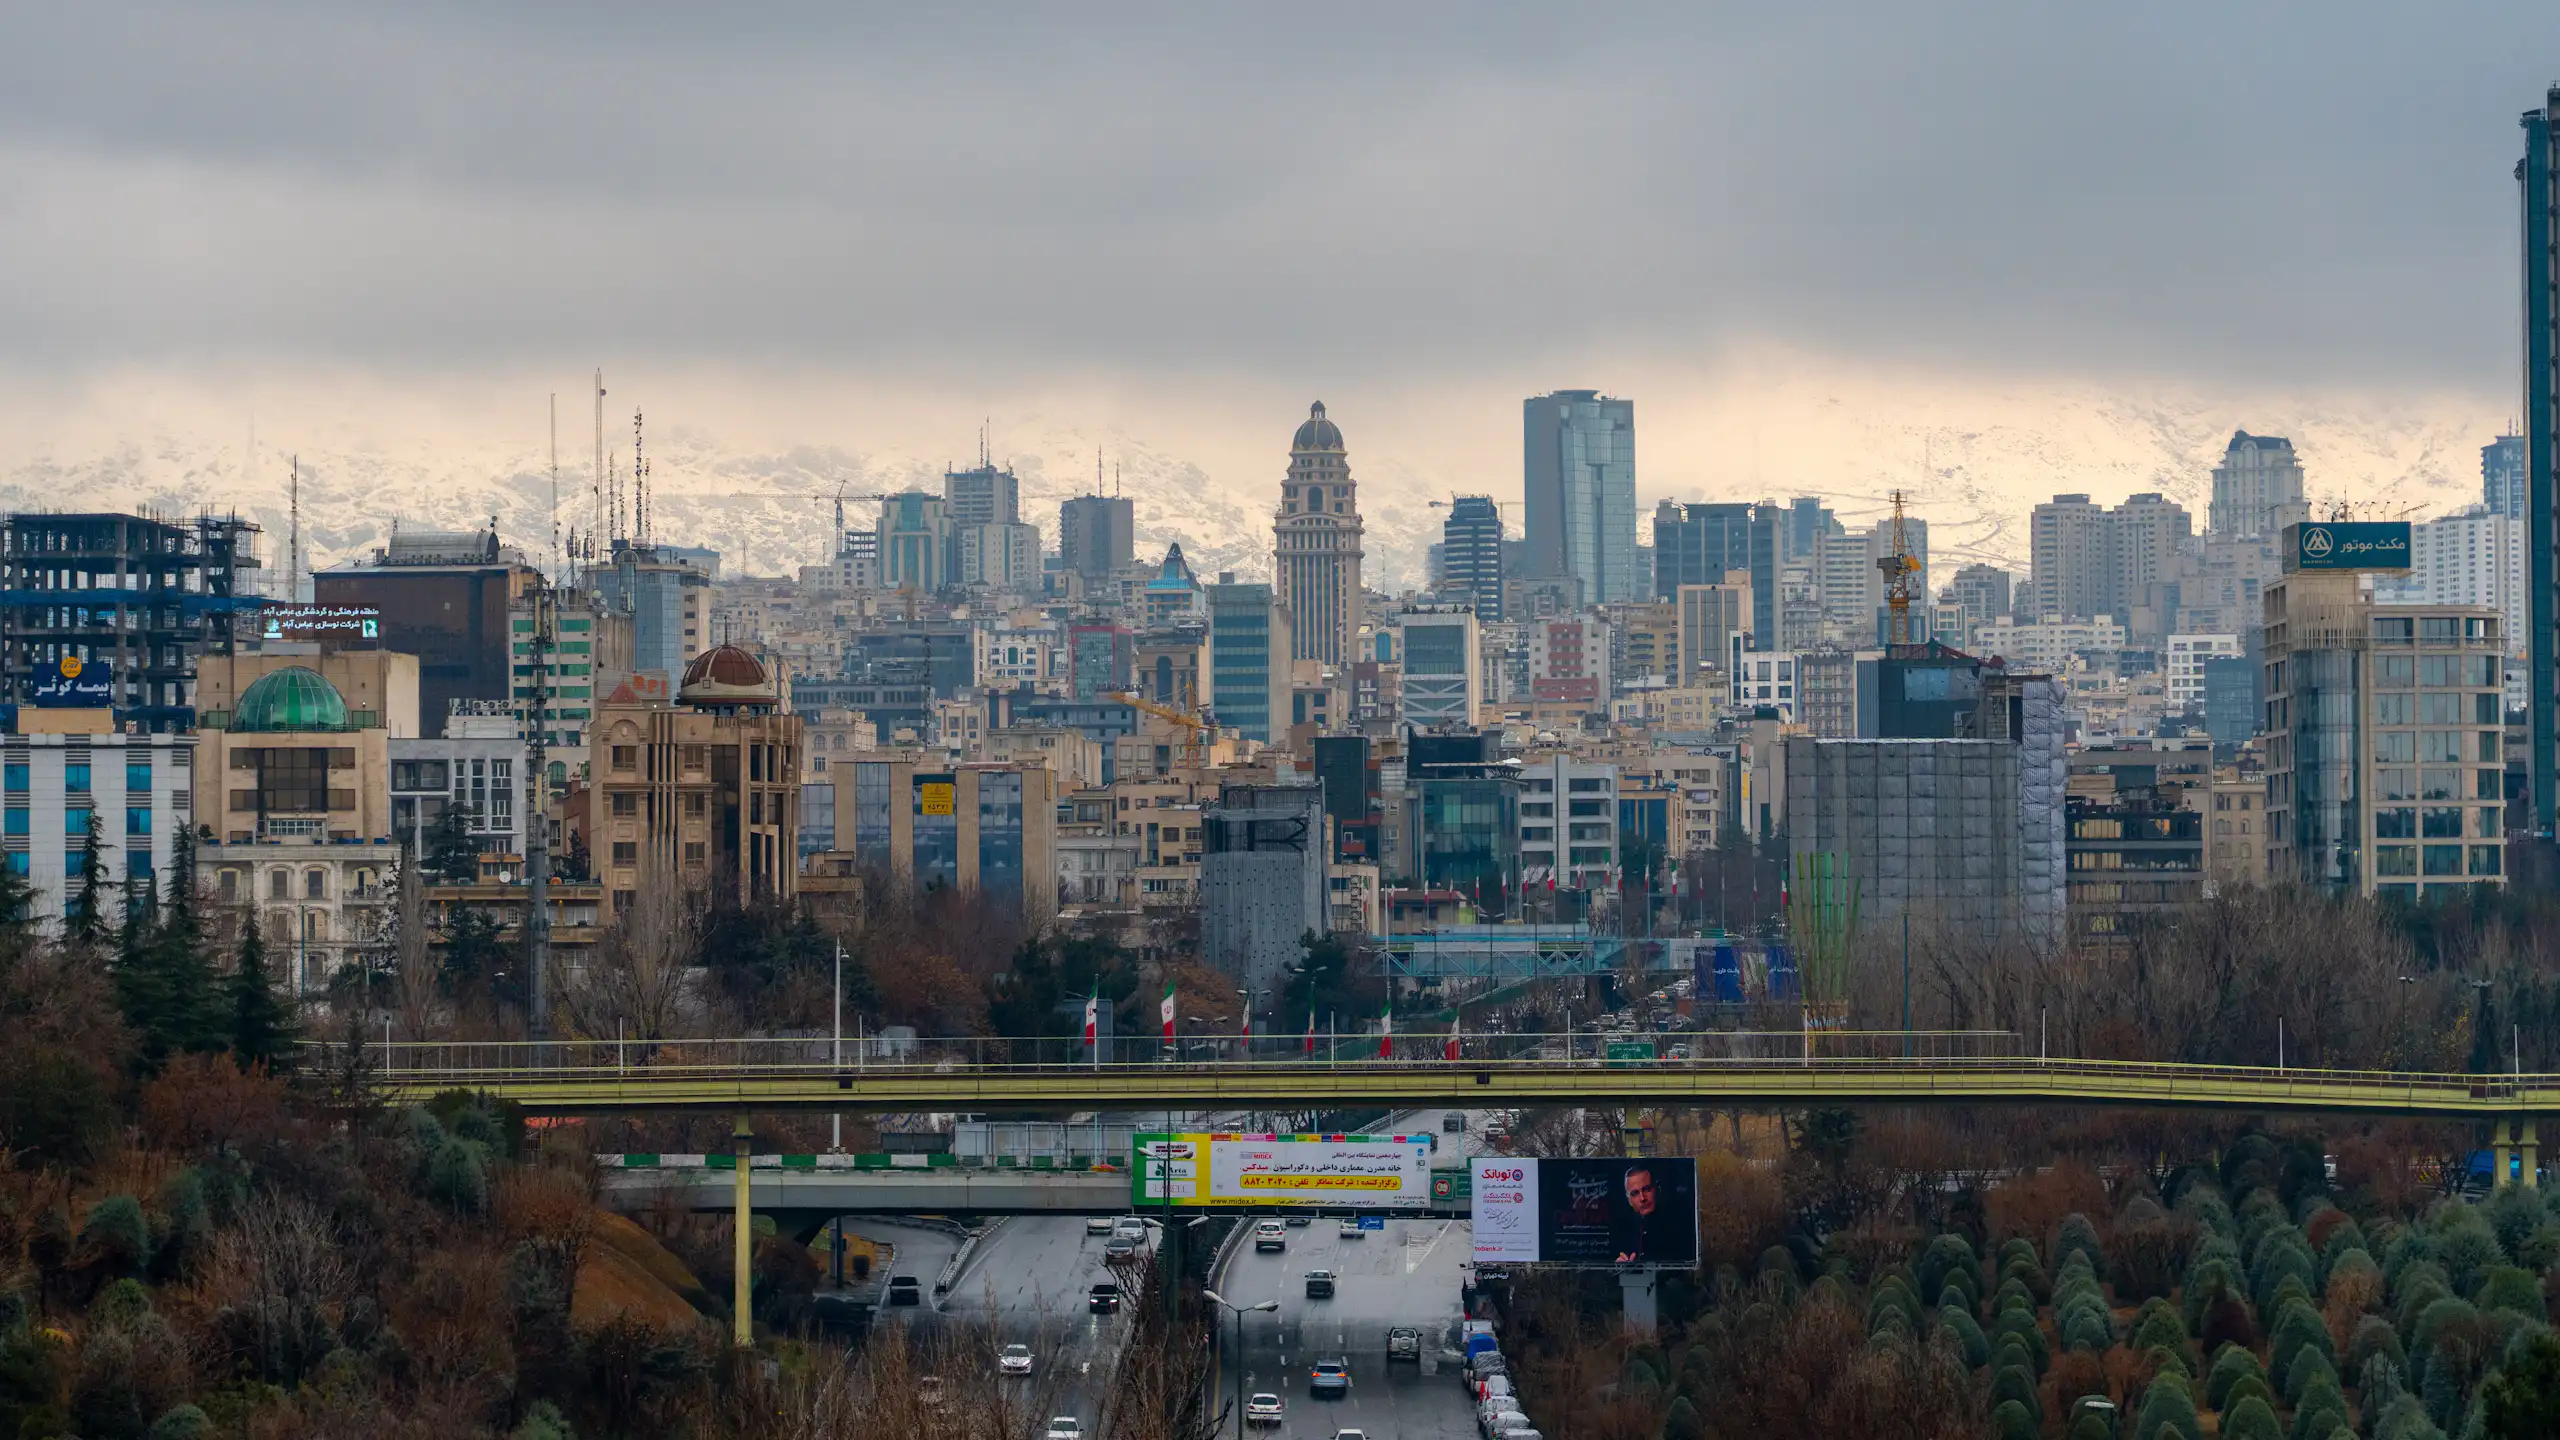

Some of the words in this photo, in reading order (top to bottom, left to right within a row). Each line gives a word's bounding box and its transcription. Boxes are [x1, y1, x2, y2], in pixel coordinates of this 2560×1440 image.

[2340, 540, 2374, 554] موتور
[2376, 537, 2406, 551] مکث
[263, 606, 276, 617] آباد
[276, 607, 295, 617] عباس
[295, 606, 328, 617] گردشگری
[333, 607, 359, 617] فرهنگی
[282, 618, 295, 629] آباد
[294, 620, 314, 629] عباس
[315, 619, 340, 630] نوسازی
[340, 619, 361, 629] شرکت
[35, 675, 73, 696] کوثر
[75, 682, 110, 696] بیمه
[1273, 1163, 1309, 1173] دکوراسیون
[1316, 1164, 1338, 1173] داخلی
[1339, 1165, 1364, 1173] معماری
[1387, 1165, 1402, 1173] خانه
[1335, 1178, 1354, 1187] شرکت
[1210, 1197, 1256, 1205] www.midex.ir
